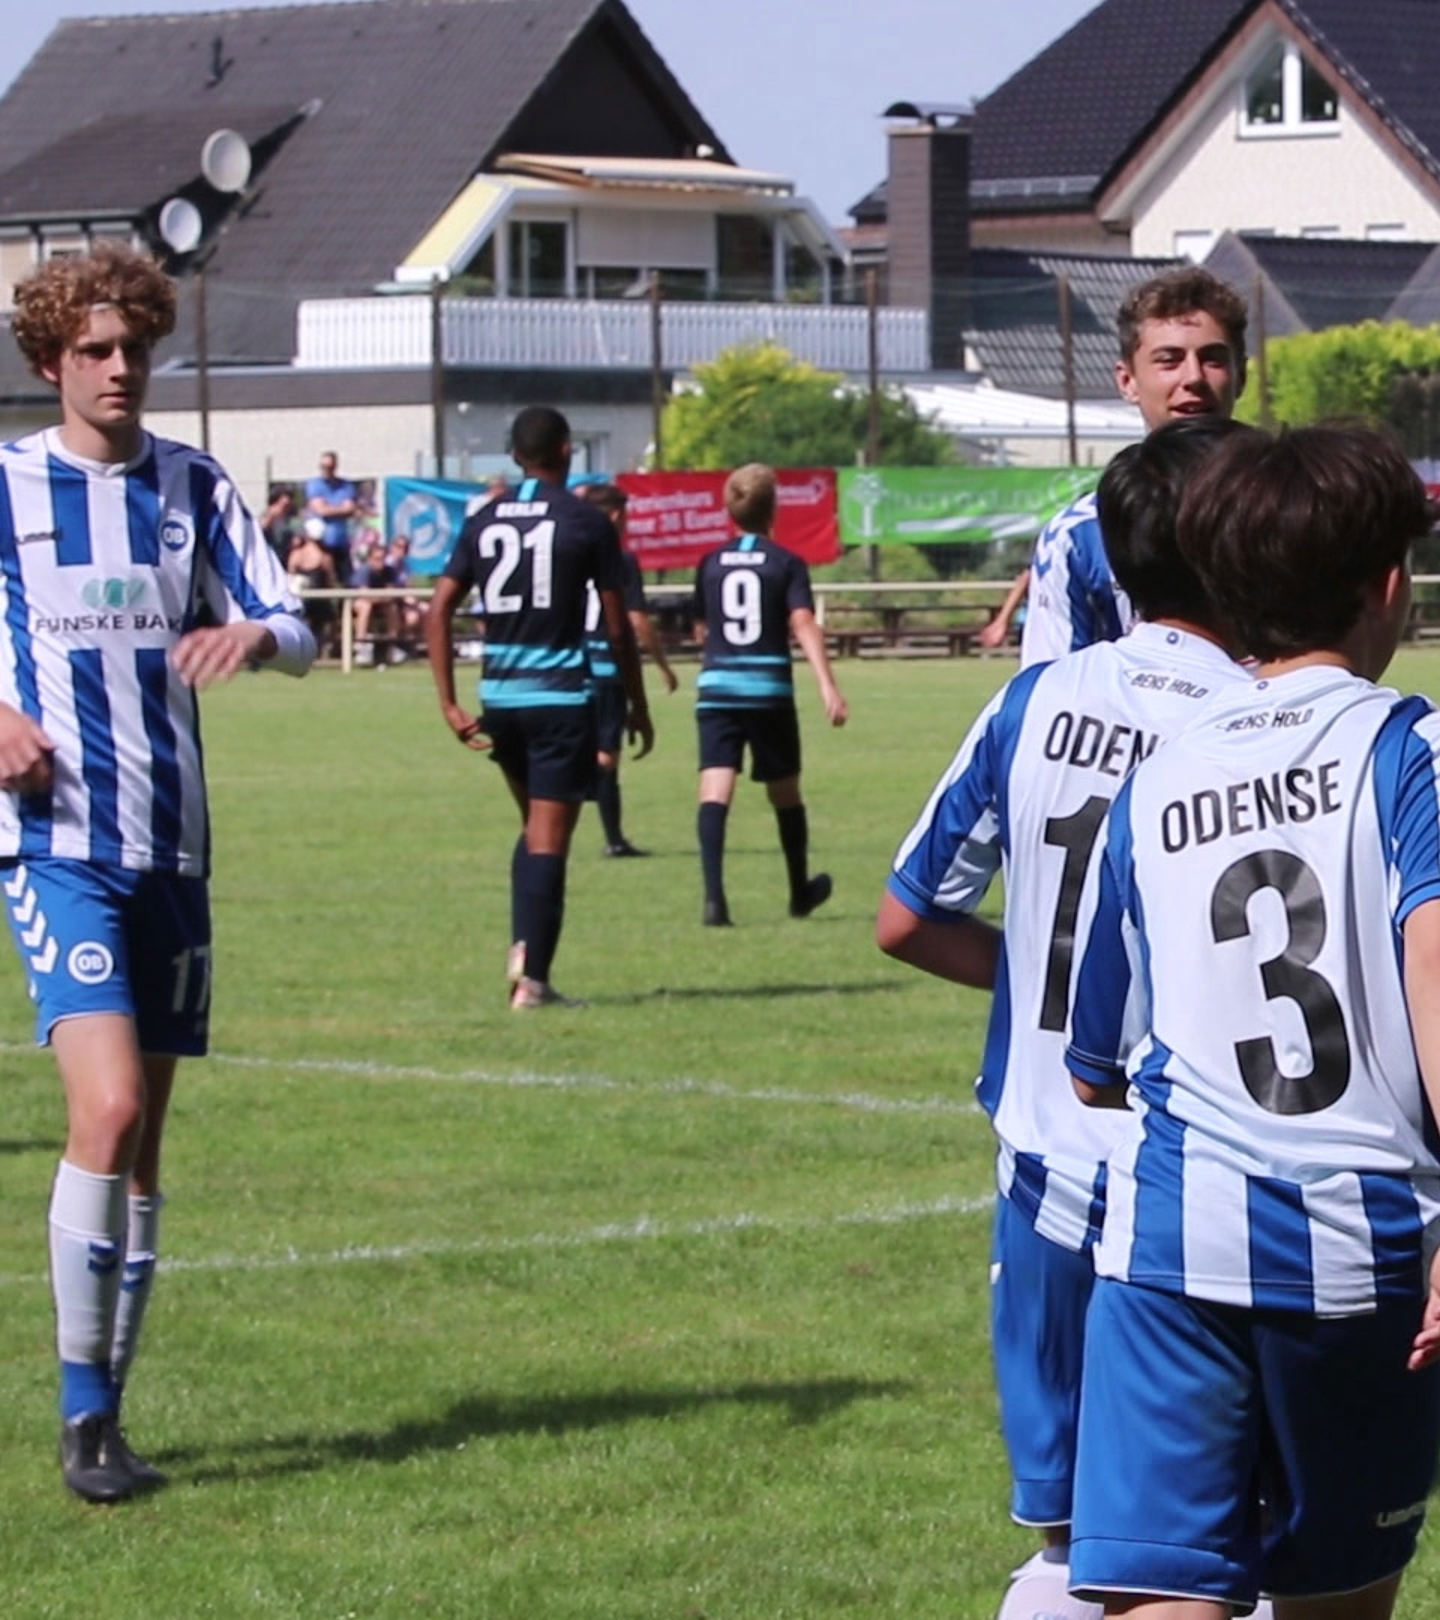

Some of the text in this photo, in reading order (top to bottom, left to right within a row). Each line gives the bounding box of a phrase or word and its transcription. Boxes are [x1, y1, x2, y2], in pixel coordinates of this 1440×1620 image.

[479, 520, 555, 614] 21
[36, 614, 125, 633] FYNSKE
[722, 568, 762, 646] 9
[1167, 679, 1209, 699] HOLD
[1271, 708, 1314, 728] HOLD
[1044, 710, 1159, 779] ODEN
[1161, 760, 1342, 853] ODENSE
[1039, 795, 1111, 1032] 1
[1211, 849, 1350, 1116] 3
